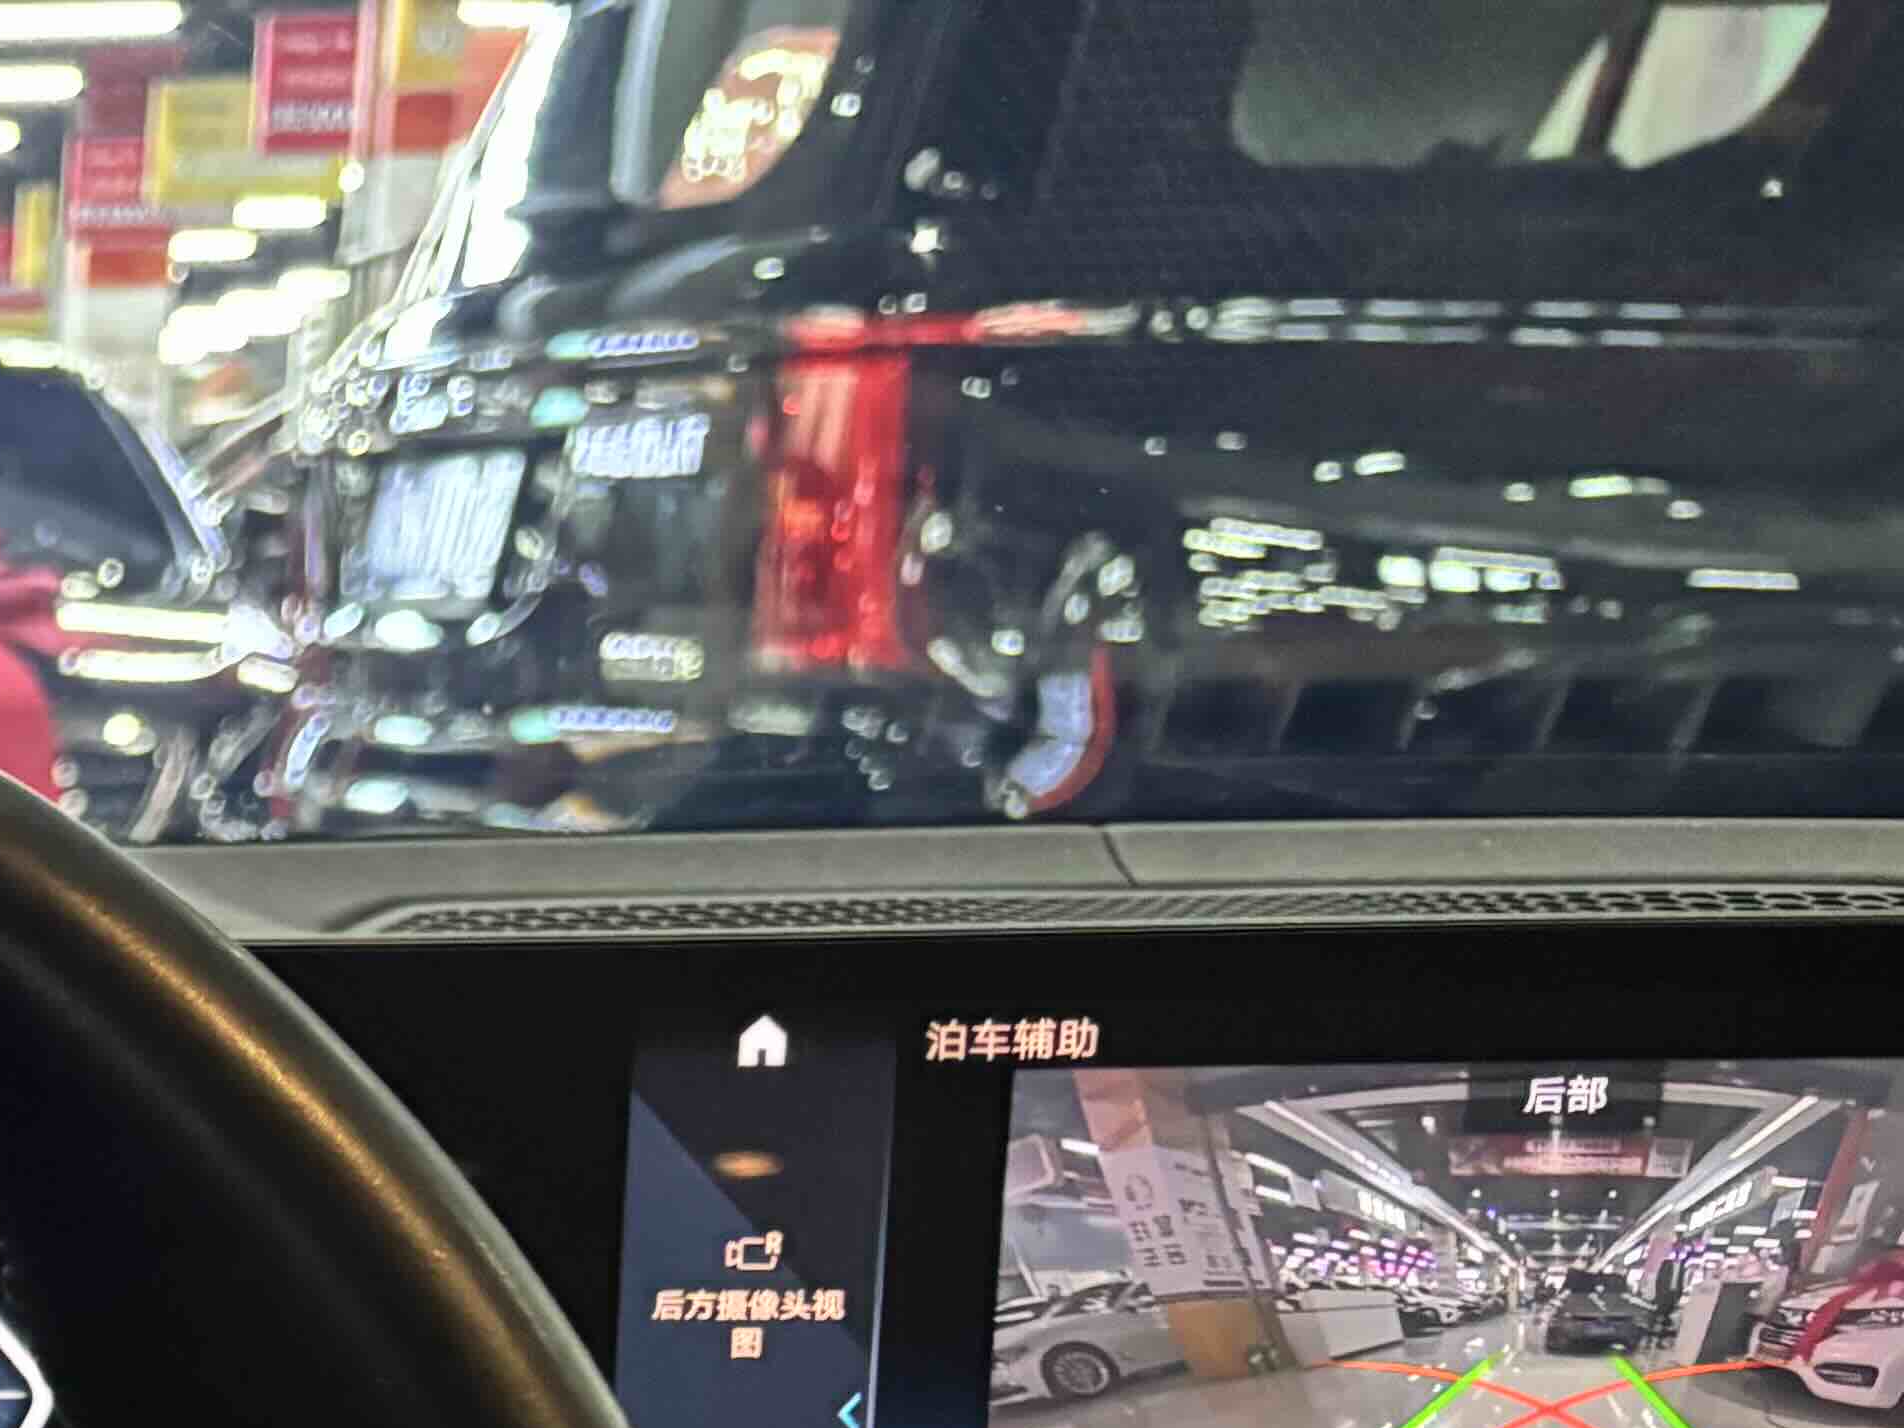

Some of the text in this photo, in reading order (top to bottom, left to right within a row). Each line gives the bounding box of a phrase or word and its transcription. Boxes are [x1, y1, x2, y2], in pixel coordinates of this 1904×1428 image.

[926, 1017, 1099, 1061] 泊车辅助
[1523, 1075, 1609, 1115] 后部
[730, 1327, 763, 1359] 图
